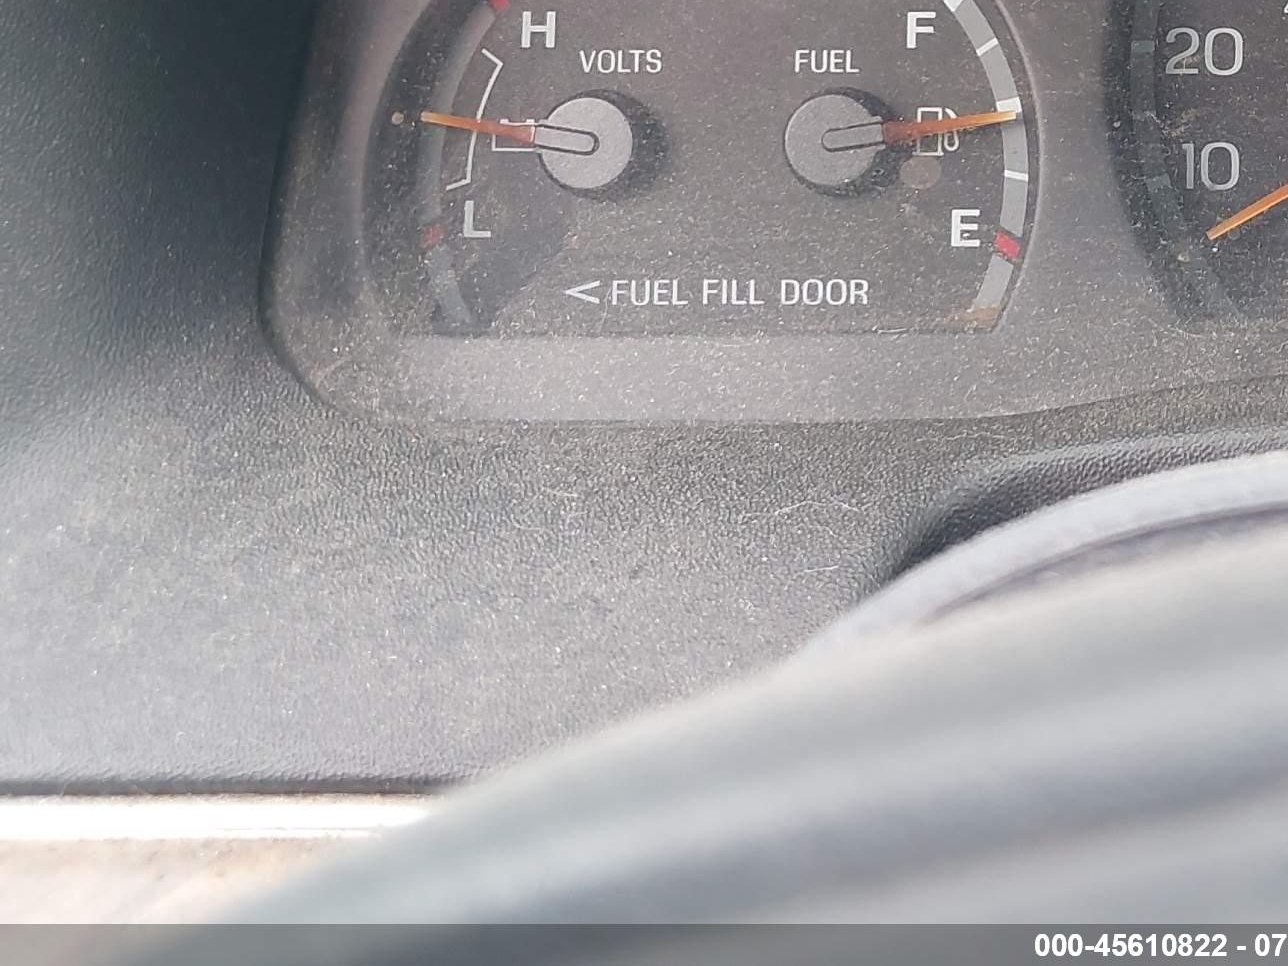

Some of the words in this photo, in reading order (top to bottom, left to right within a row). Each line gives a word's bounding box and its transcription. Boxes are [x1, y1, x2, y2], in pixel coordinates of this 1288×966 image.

[521, 11, 557, 48] H
[905, 11, 936, 48] F
[579, 50, 662, 73] VOLTS
[794, 50, 859, 73] FUEL
[1165, 27, 1243, 75] 20
[1182, 142, 1240, 190] 10
[463, 201, 491, 237] L
[950, 209, 980, 246] E
[611, 280, 688, 304] FUEL
[703, 280, 764, 304] FILL
[780, 280, 869, 304] DOOR
